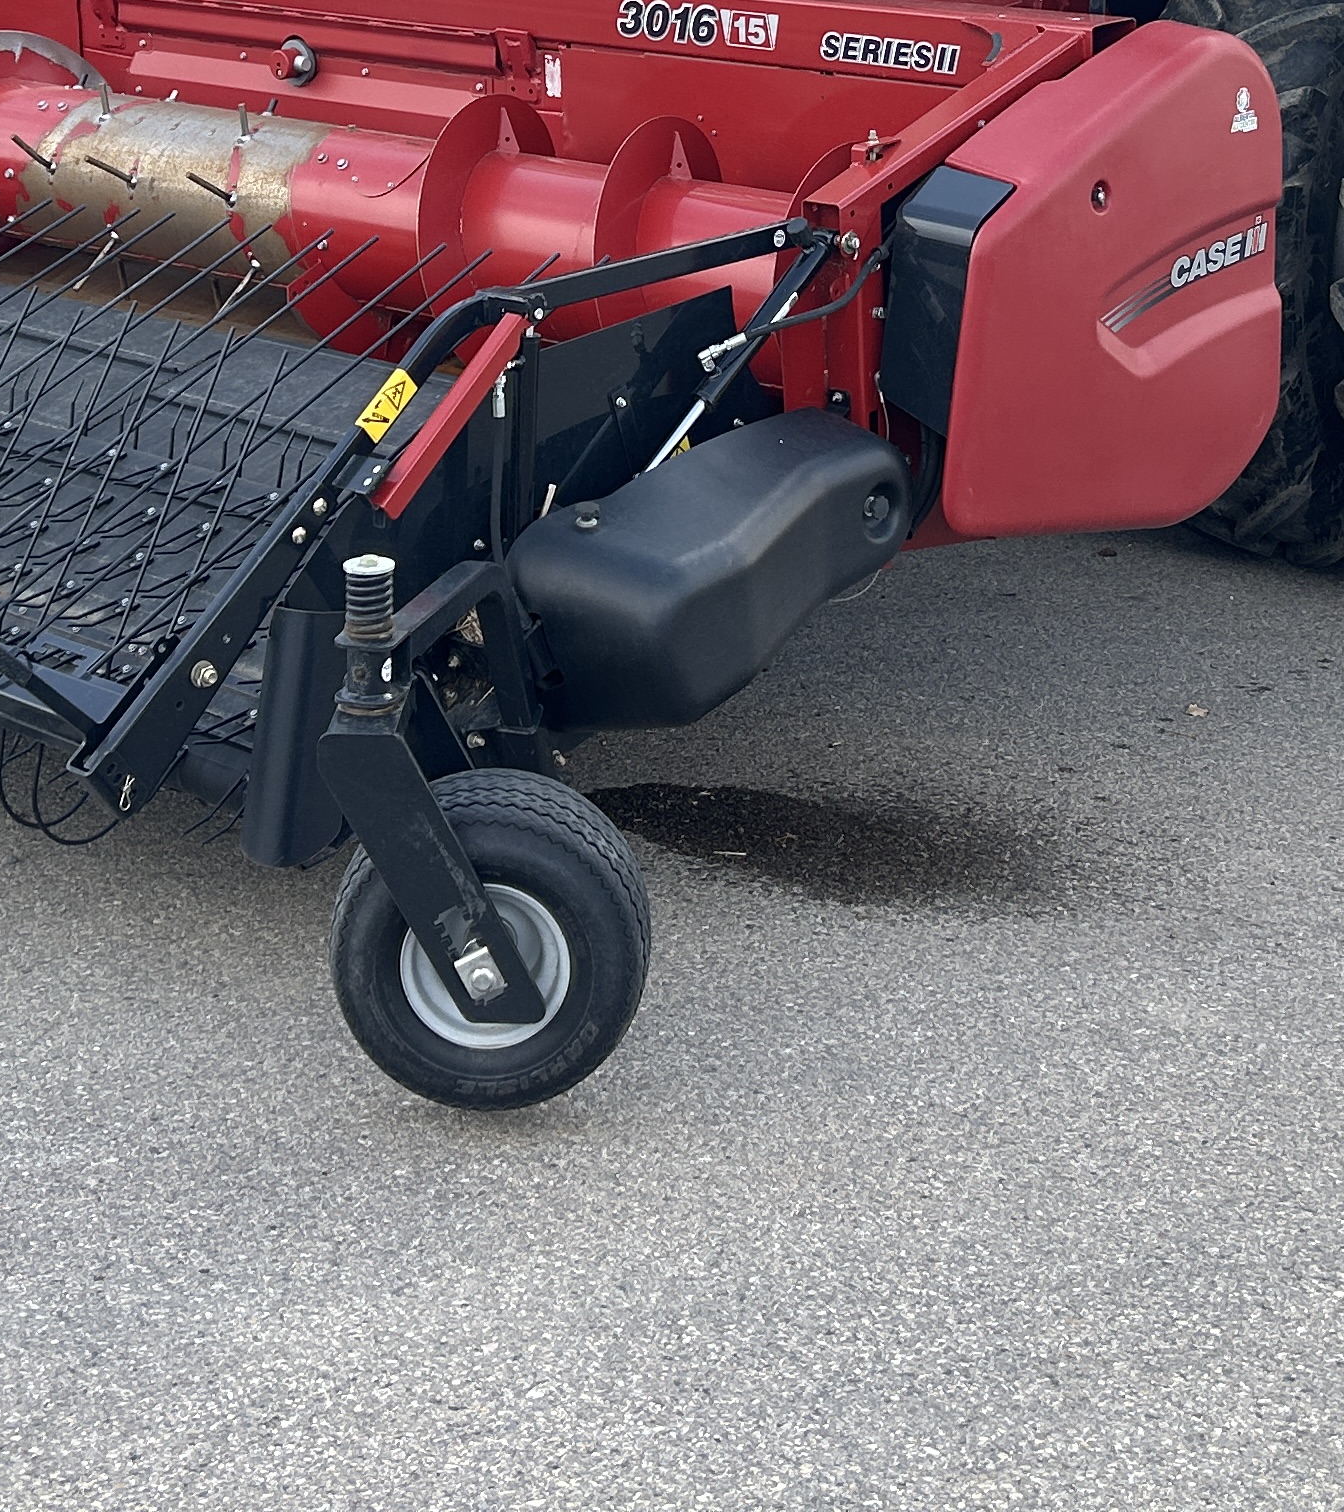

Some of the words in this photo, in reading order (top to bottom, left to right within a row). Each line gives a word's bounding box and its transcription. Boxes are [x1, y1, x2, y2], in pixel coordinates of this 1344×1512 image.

[733, 15, 767, 45] 15
[820, 31, 934, 72] SERIES
[933, 44, 961, 75] II
[1170, 232, 1244, 288] CASE
